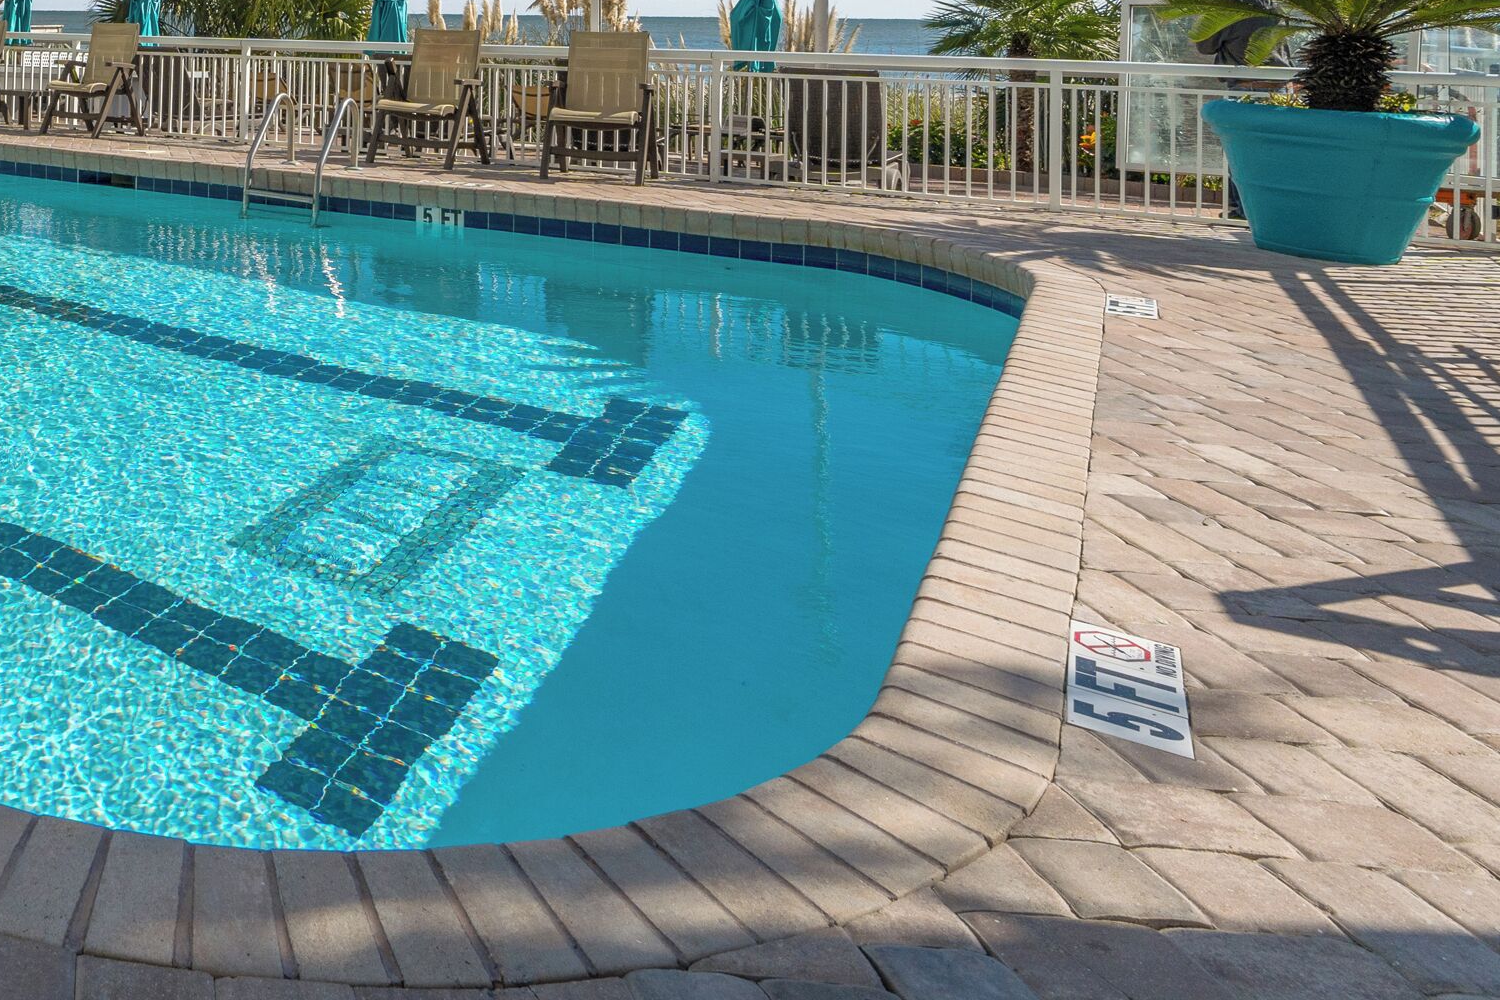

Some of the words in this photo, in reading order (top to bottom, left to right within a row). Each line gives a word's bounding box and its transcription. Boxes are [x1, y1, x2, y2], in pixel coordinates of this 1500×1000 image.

[423, 207, 433, 224] 5
[441, 207, 462, 226] FT
[1154, 643, 1176, 668] DIVING
[1075, 655, 1180, 714] FT
[1155, 665, 1177, 679] NO
[1073, 699, 1185, 741] 5
